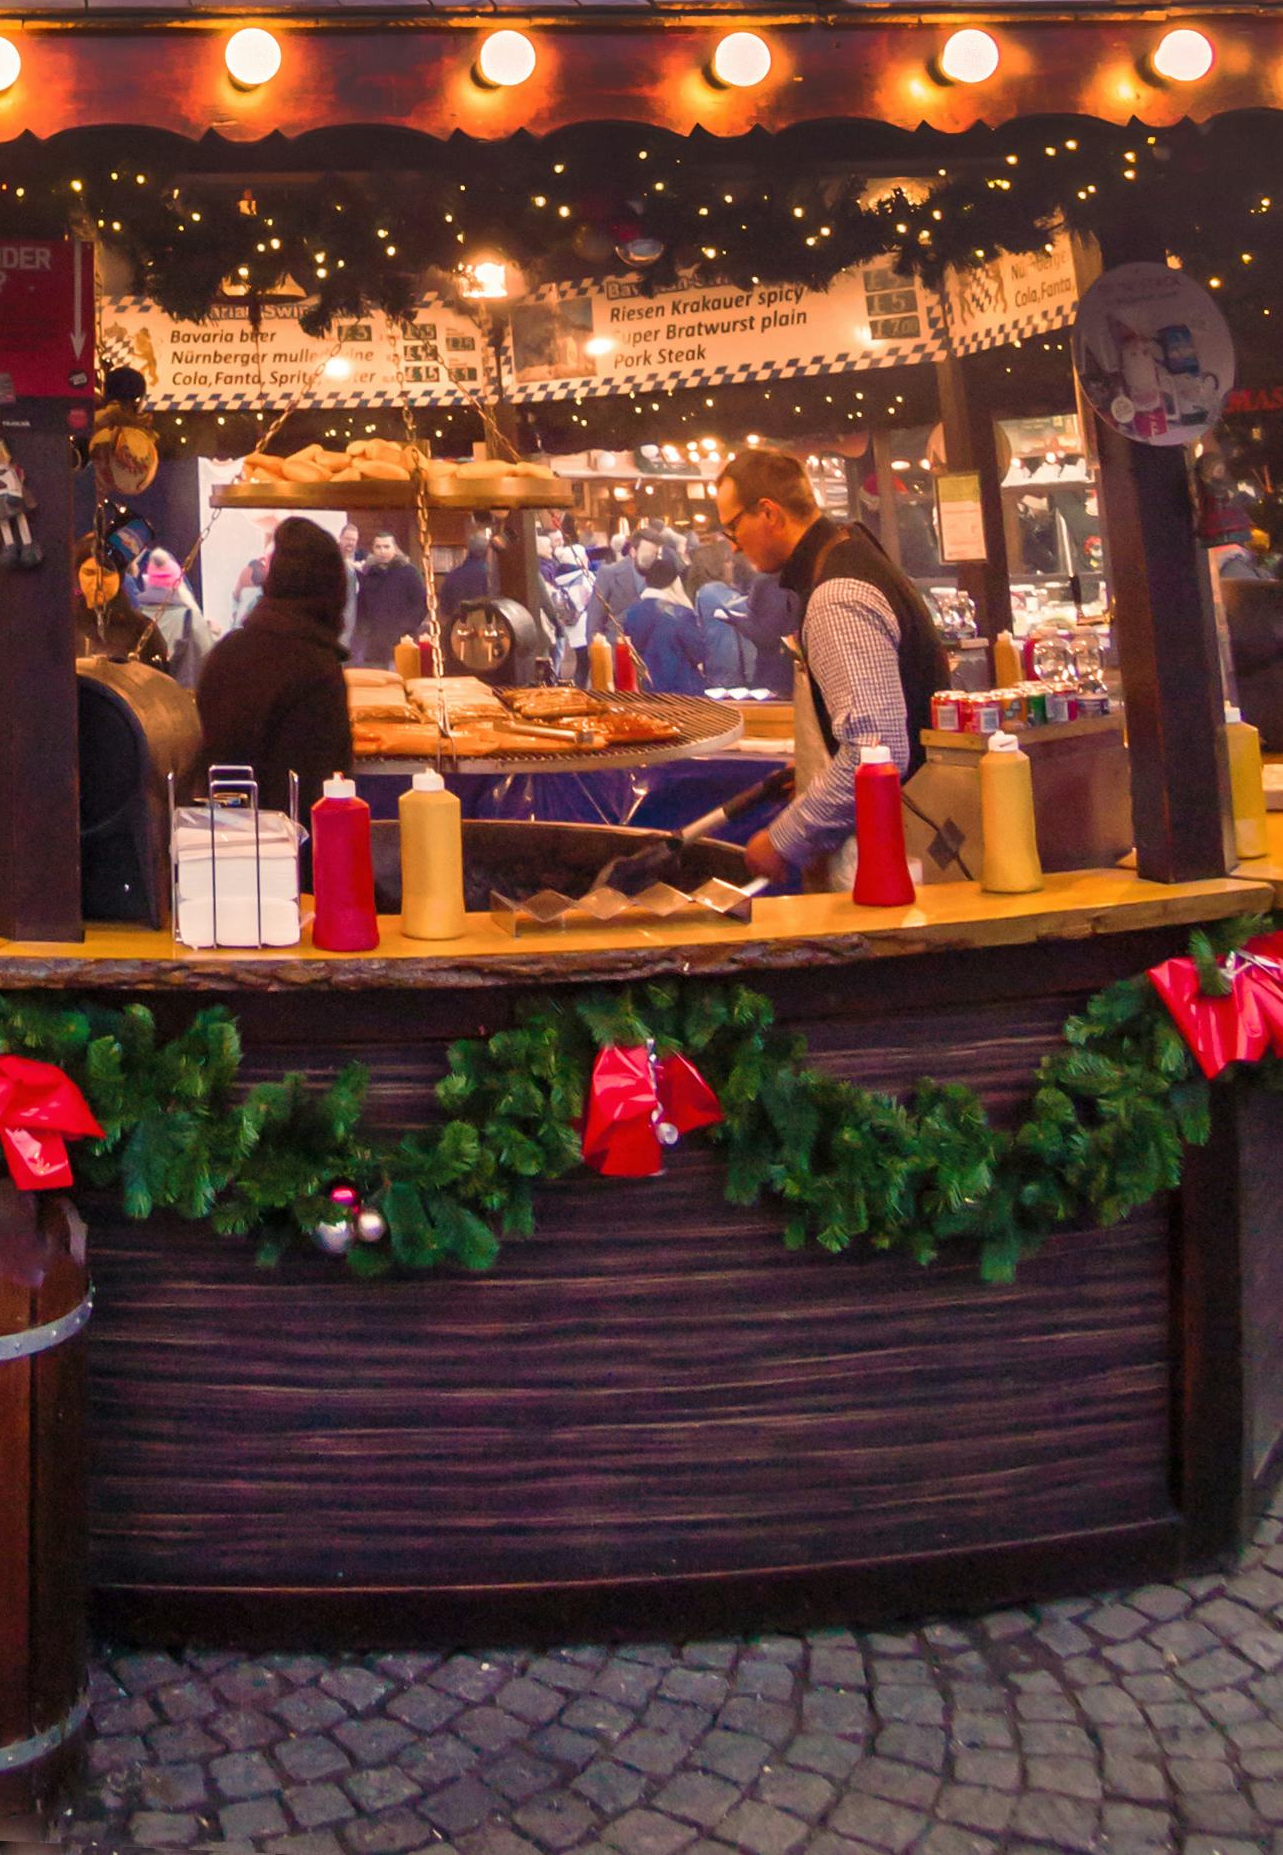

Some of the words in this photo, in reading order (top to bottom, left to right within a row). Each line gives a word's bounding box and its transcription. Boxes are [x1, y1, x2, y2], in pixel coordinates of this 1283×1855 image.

[609, 303, 666, 323] Riesen
[670, 291, 754, 317] Krakauer
[757, 285, 806, 307] spicy
[169, 329, 235, 344] Bavaria
[239, 328, 277, 344] beer
[665, 314, 757, 340] Bratwurst
[760, 308, 808, 334] plain
[170, 349, 267, 367] Nürnberger
[614, 352, 653, 370] Pork
[657, 343, 707, 365] Steak
